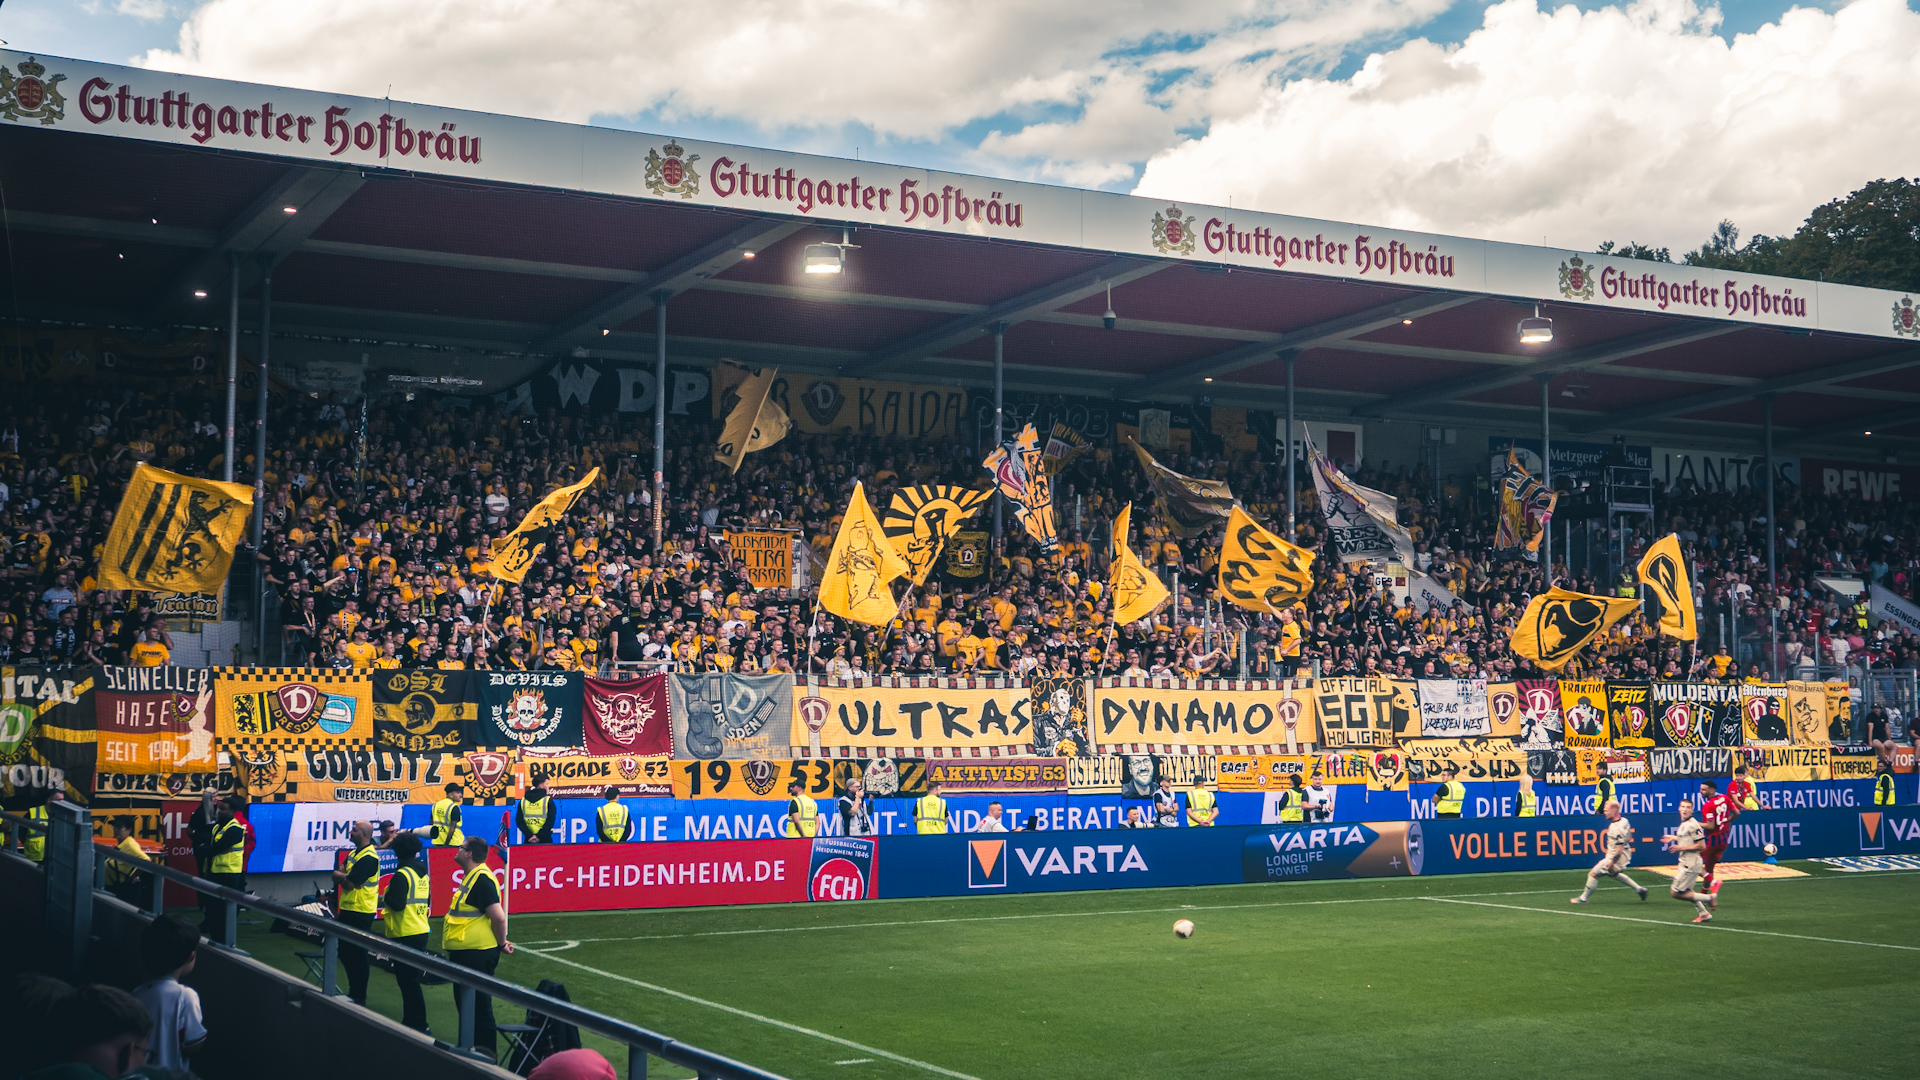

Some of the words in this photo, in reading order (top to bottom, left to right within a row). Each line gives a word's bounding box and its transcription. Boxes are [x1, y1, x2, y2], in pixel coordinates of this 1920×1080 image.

[79, 76, 315, 145] Stuttgarter
[323, 105, 481, 165] Hofbräu
[710, 156, 892, 214] Stuttgarter
[899, 177, 1024, 228] Hofbräu
[1203, 217, 1350, 268] Stuttgarter
[1355, 234, 1456, 282] Hofbräu
[1600, 265, 1719, 310] Stuttgarter
[1724, 280, 1808, 318] Hofbräu
[103, 664, 209, 693] SCHNELLER
[1320, 679, 1387, 693] OFFICIAL
[116, 699, 171, 727] HASE
[273, 708, 322, 734] DRESDEN
[838, 698, 1031, 741] ULTRAS
[1101, 697, 1274, 737] DYNAMO
[1319, 694, 1393, 730] SGD
[106, 741, 139, 763] SEIT
[147, 740, 179, 764] 1984
[1566, 737, 1608, 747] ROHBURG
[529, 761, 612, 779] BRIGADE
[644, 760, 669, 778] 53
[929, 765, 1040, 782] AKTIVIST
[1041, 765, 1066, 781] 53
[1220, 761, 1249, 774] EAST
[1271, 761, 1305, 775] CREW
[1650, 750, 1731, 775] WALDHEIM
[684, 760, 732, 795] 19
[790, 759, 832, 794] 53
[1475, 797, 1512, 817] DIE
[1268, 825, 1366, 853] VARTA
[1449, 832, 1527, 860] VOLLE
[854, 850, 869, 859] 1846
[1014, 844, 1149, 876] VARTA
[1266, 850, 1324, 867] LONGLIFE
[452, 859, 786, 893] SOP.FC-HEIDENHEIM.DE
[1267, 865, 1310, 877] POWER
[819, 874, 858, 901] FCH
